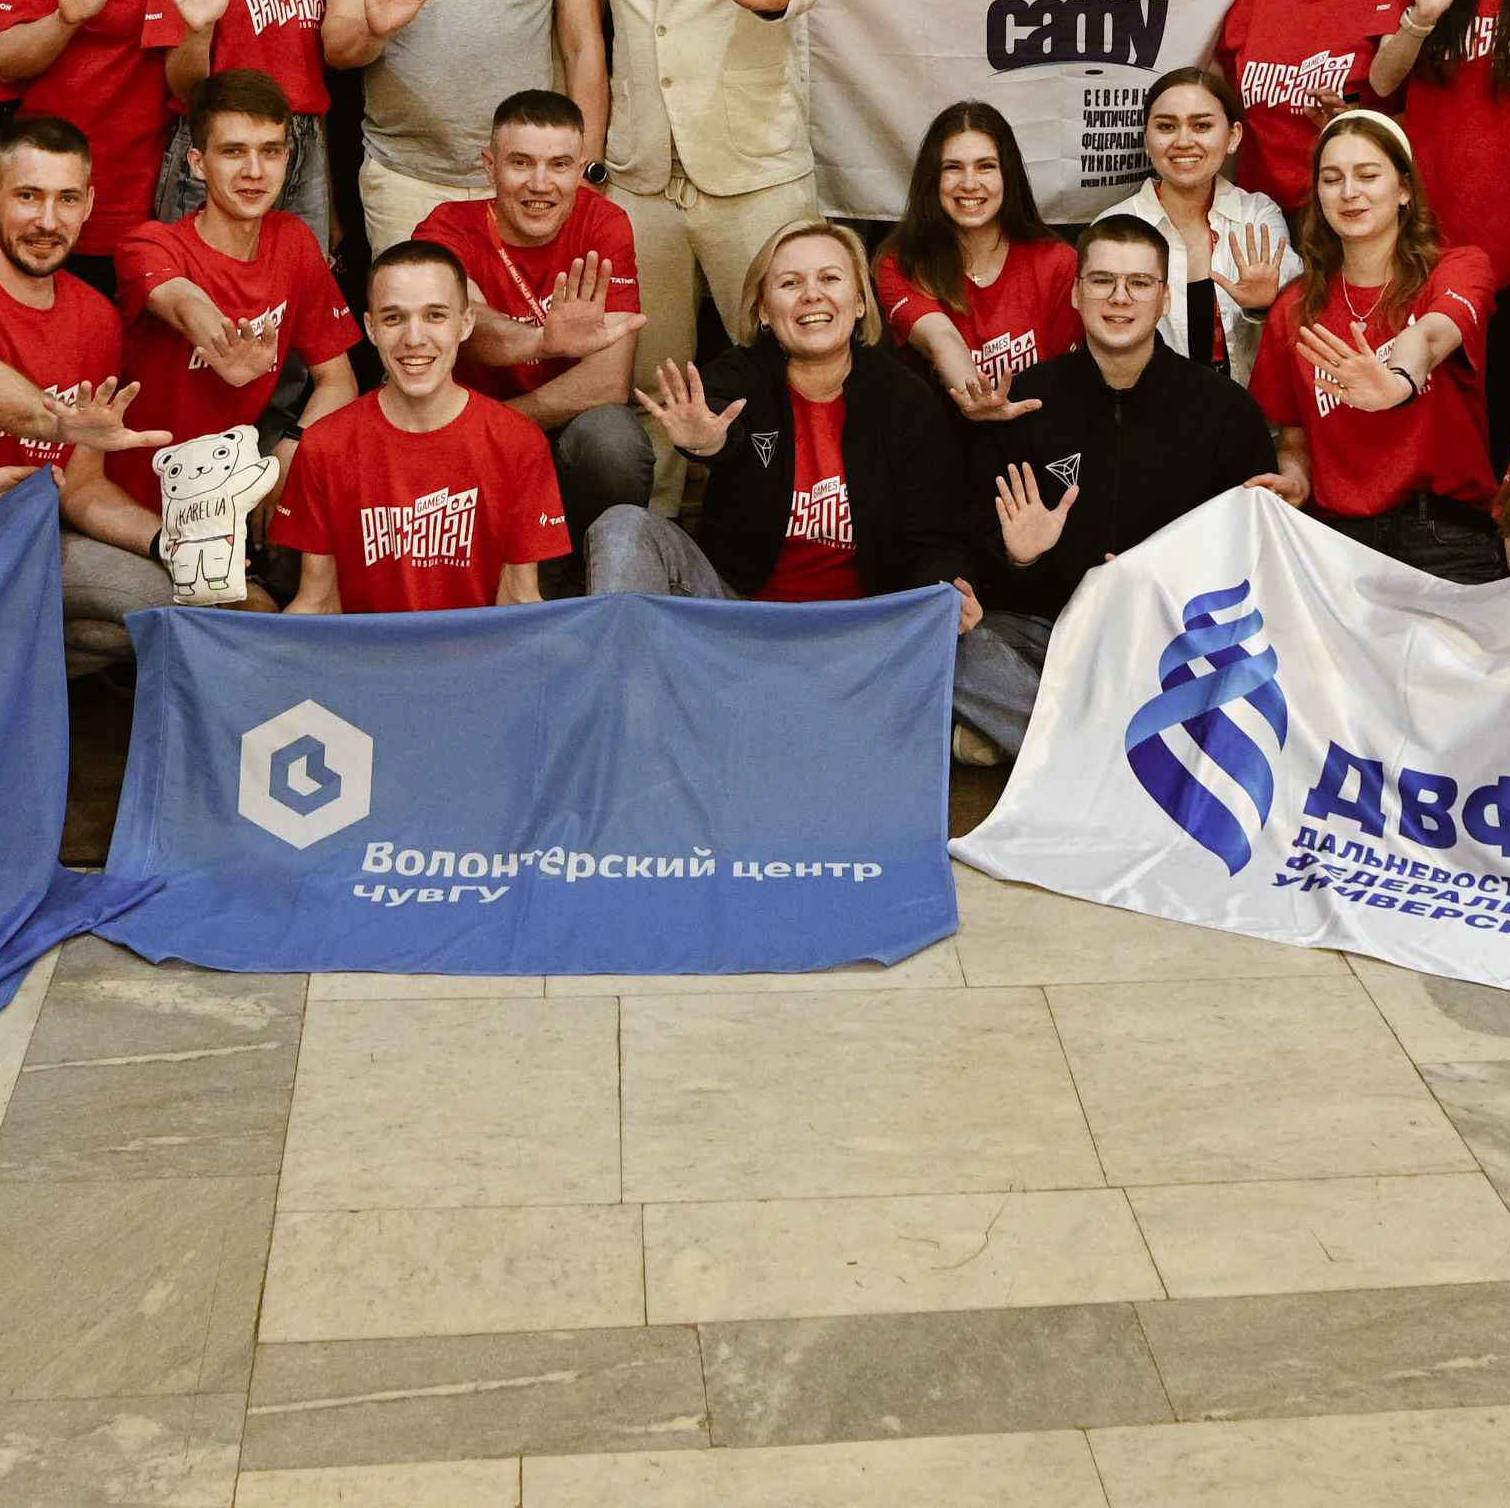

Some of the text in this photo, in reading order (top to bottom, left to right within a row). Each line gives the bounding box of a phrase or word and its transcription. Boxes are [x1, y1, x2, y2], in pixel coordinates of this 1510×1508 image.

[812, 481, 838, 498] GAMES
[177, 500, 227, 527] KARELIA
[416, 491, 446, 514] GAMES
[732, 859, 884, 882] центр
